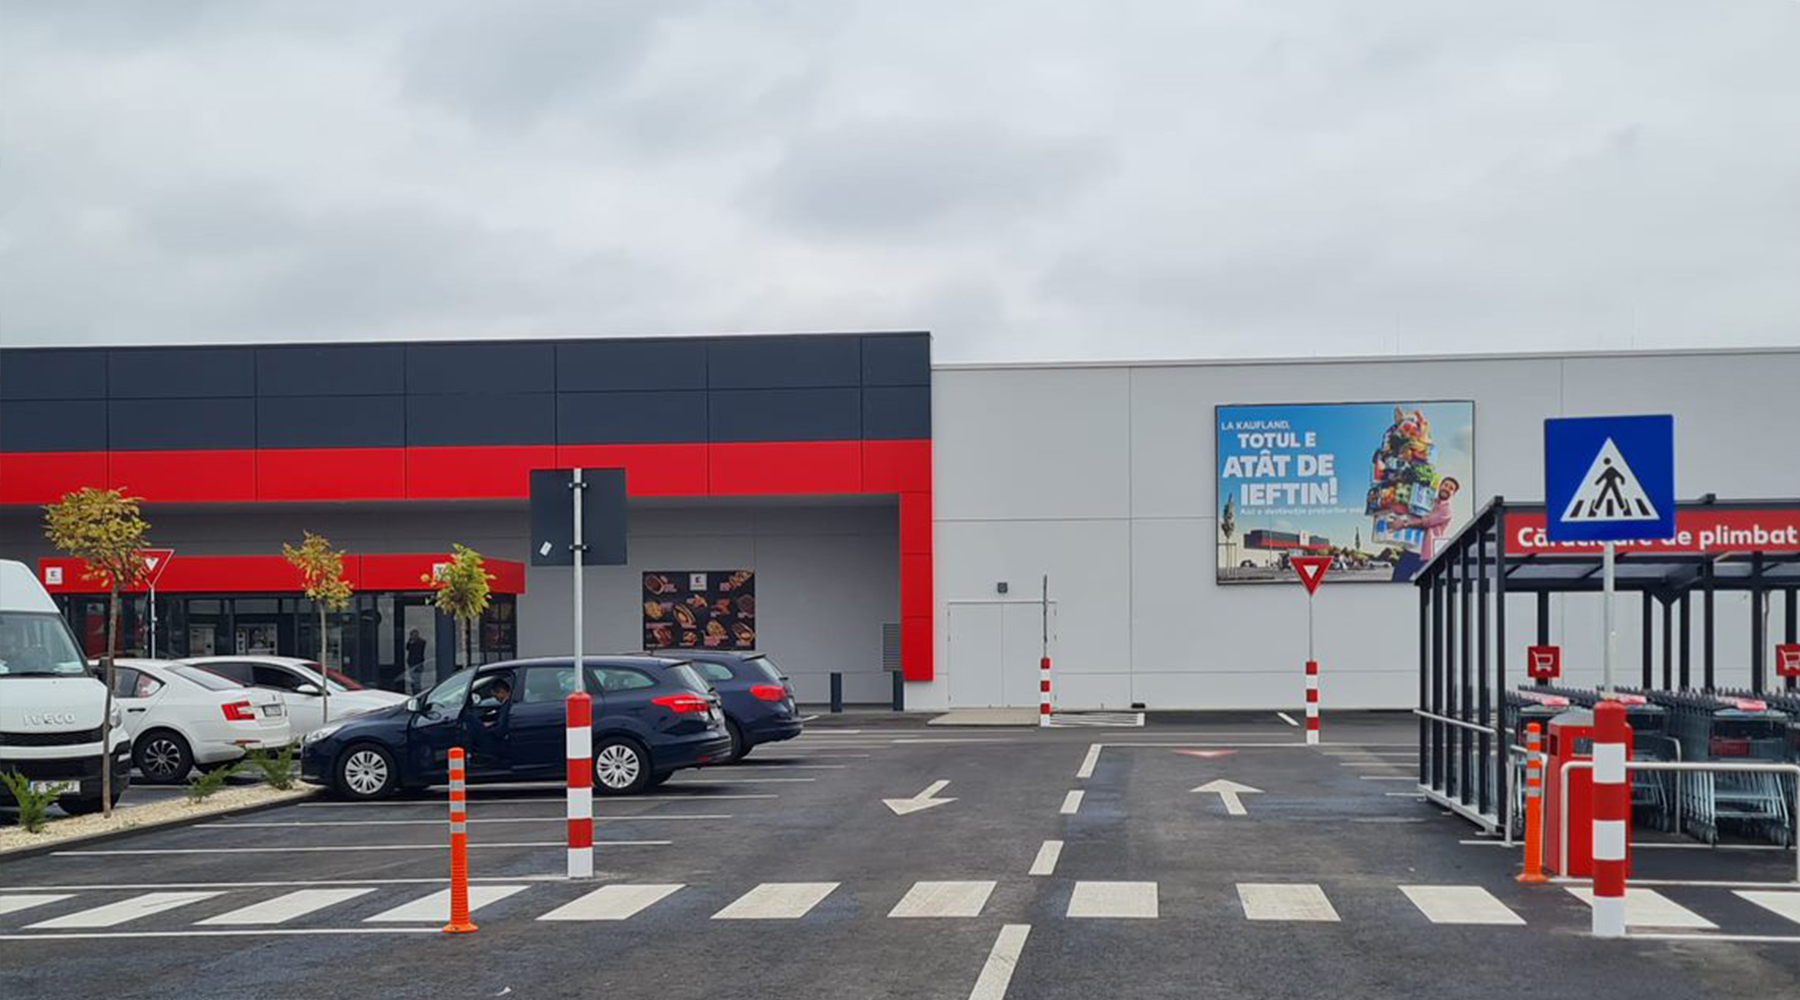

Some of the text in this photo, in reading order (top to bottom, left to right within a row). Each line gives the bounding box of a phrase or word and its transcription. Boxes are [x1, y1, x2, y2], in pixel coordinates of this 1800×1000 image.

[1221, 421, 1234, 430] LA
[1237, 431, 1317, 449] TOTUL E
[1222, 449, 1335, 478] ATÂT DE
[1240, 477, 1338, 506] IEFTIN!
[1699, 524, 1798, 550] plimbat
[23, 712, 76, 726] IVECO
